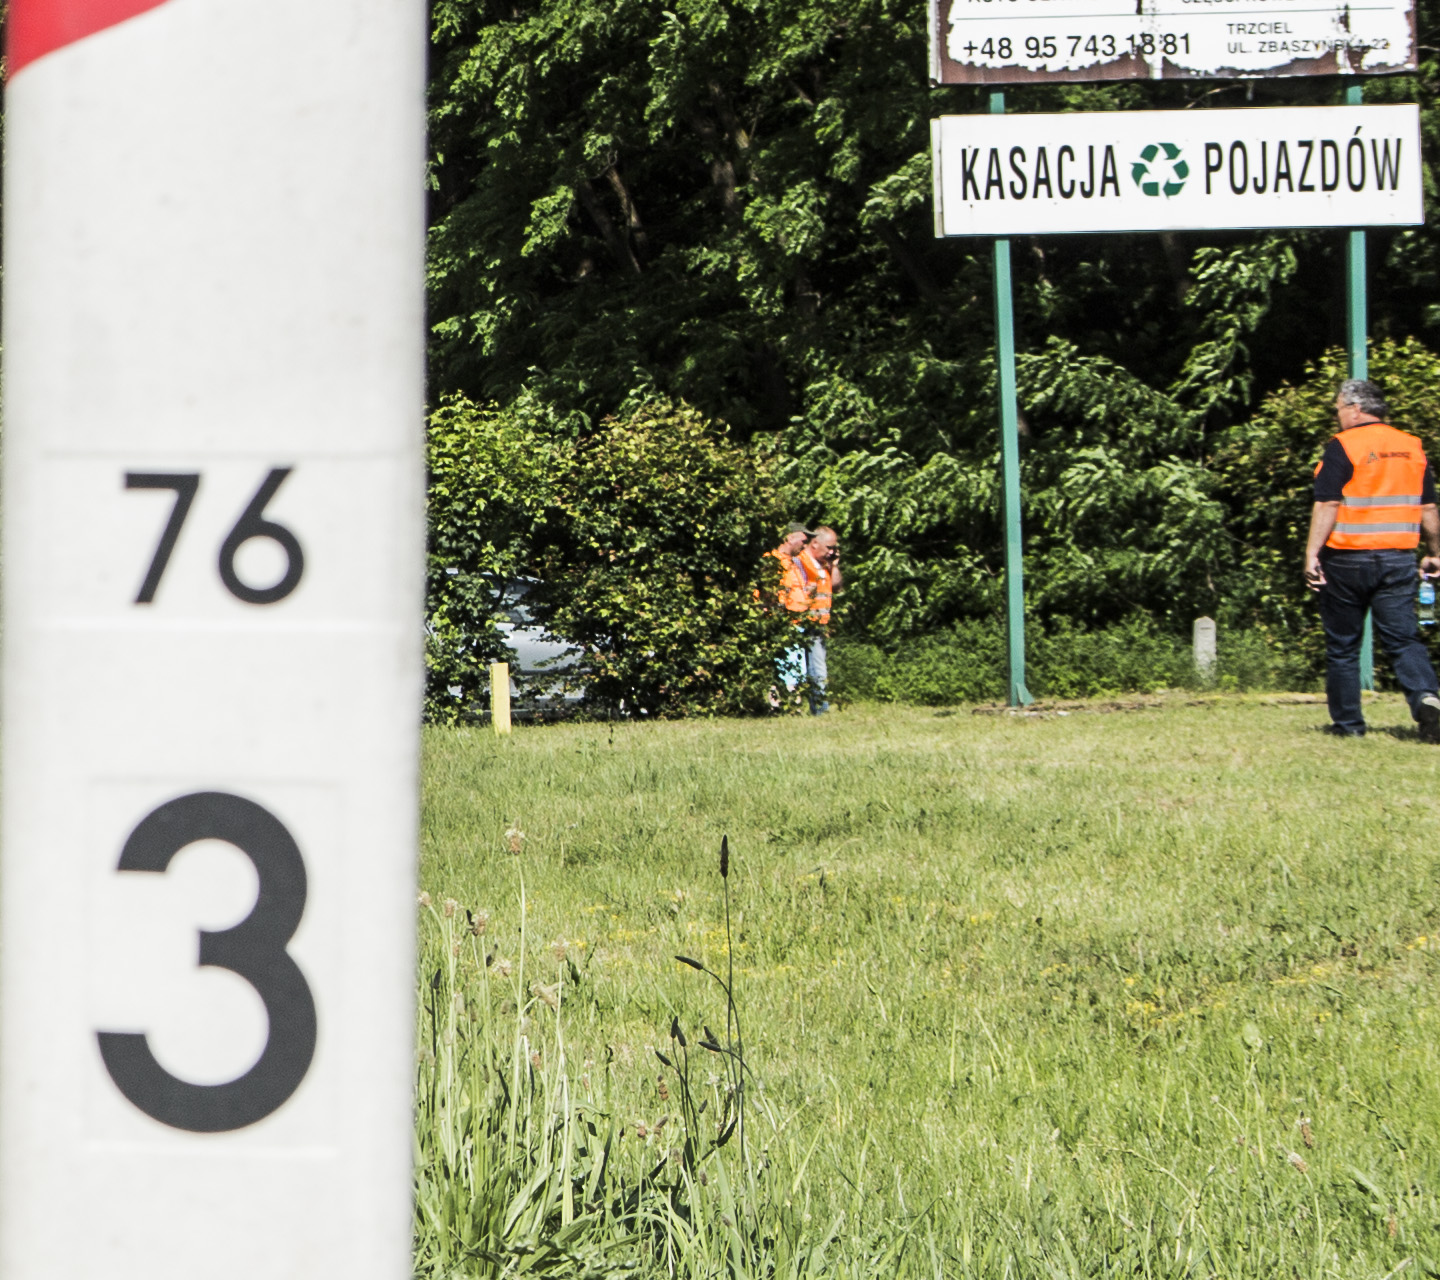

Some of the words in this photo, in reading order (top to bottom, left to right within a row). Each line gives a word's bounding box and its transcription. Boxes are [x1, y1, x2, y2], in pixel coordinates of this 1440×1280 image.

[963, 37, 1013, 60] +48
[1025, 36, 1058, 59] 95
[1066, 34, 1116, 57] 743
[1126, 32, 1190, 56] 1881
[1226, 22, 1293, 35] TRZCIEL
[1227, 41, 1253, 54] UL.
[961, 144, 1121, 201] KASACJA
[1203, 126, 1403, 196] POJAZDÓW
[122, 465, 306, 607] 76
[94, 790, 318, 1135] 3
